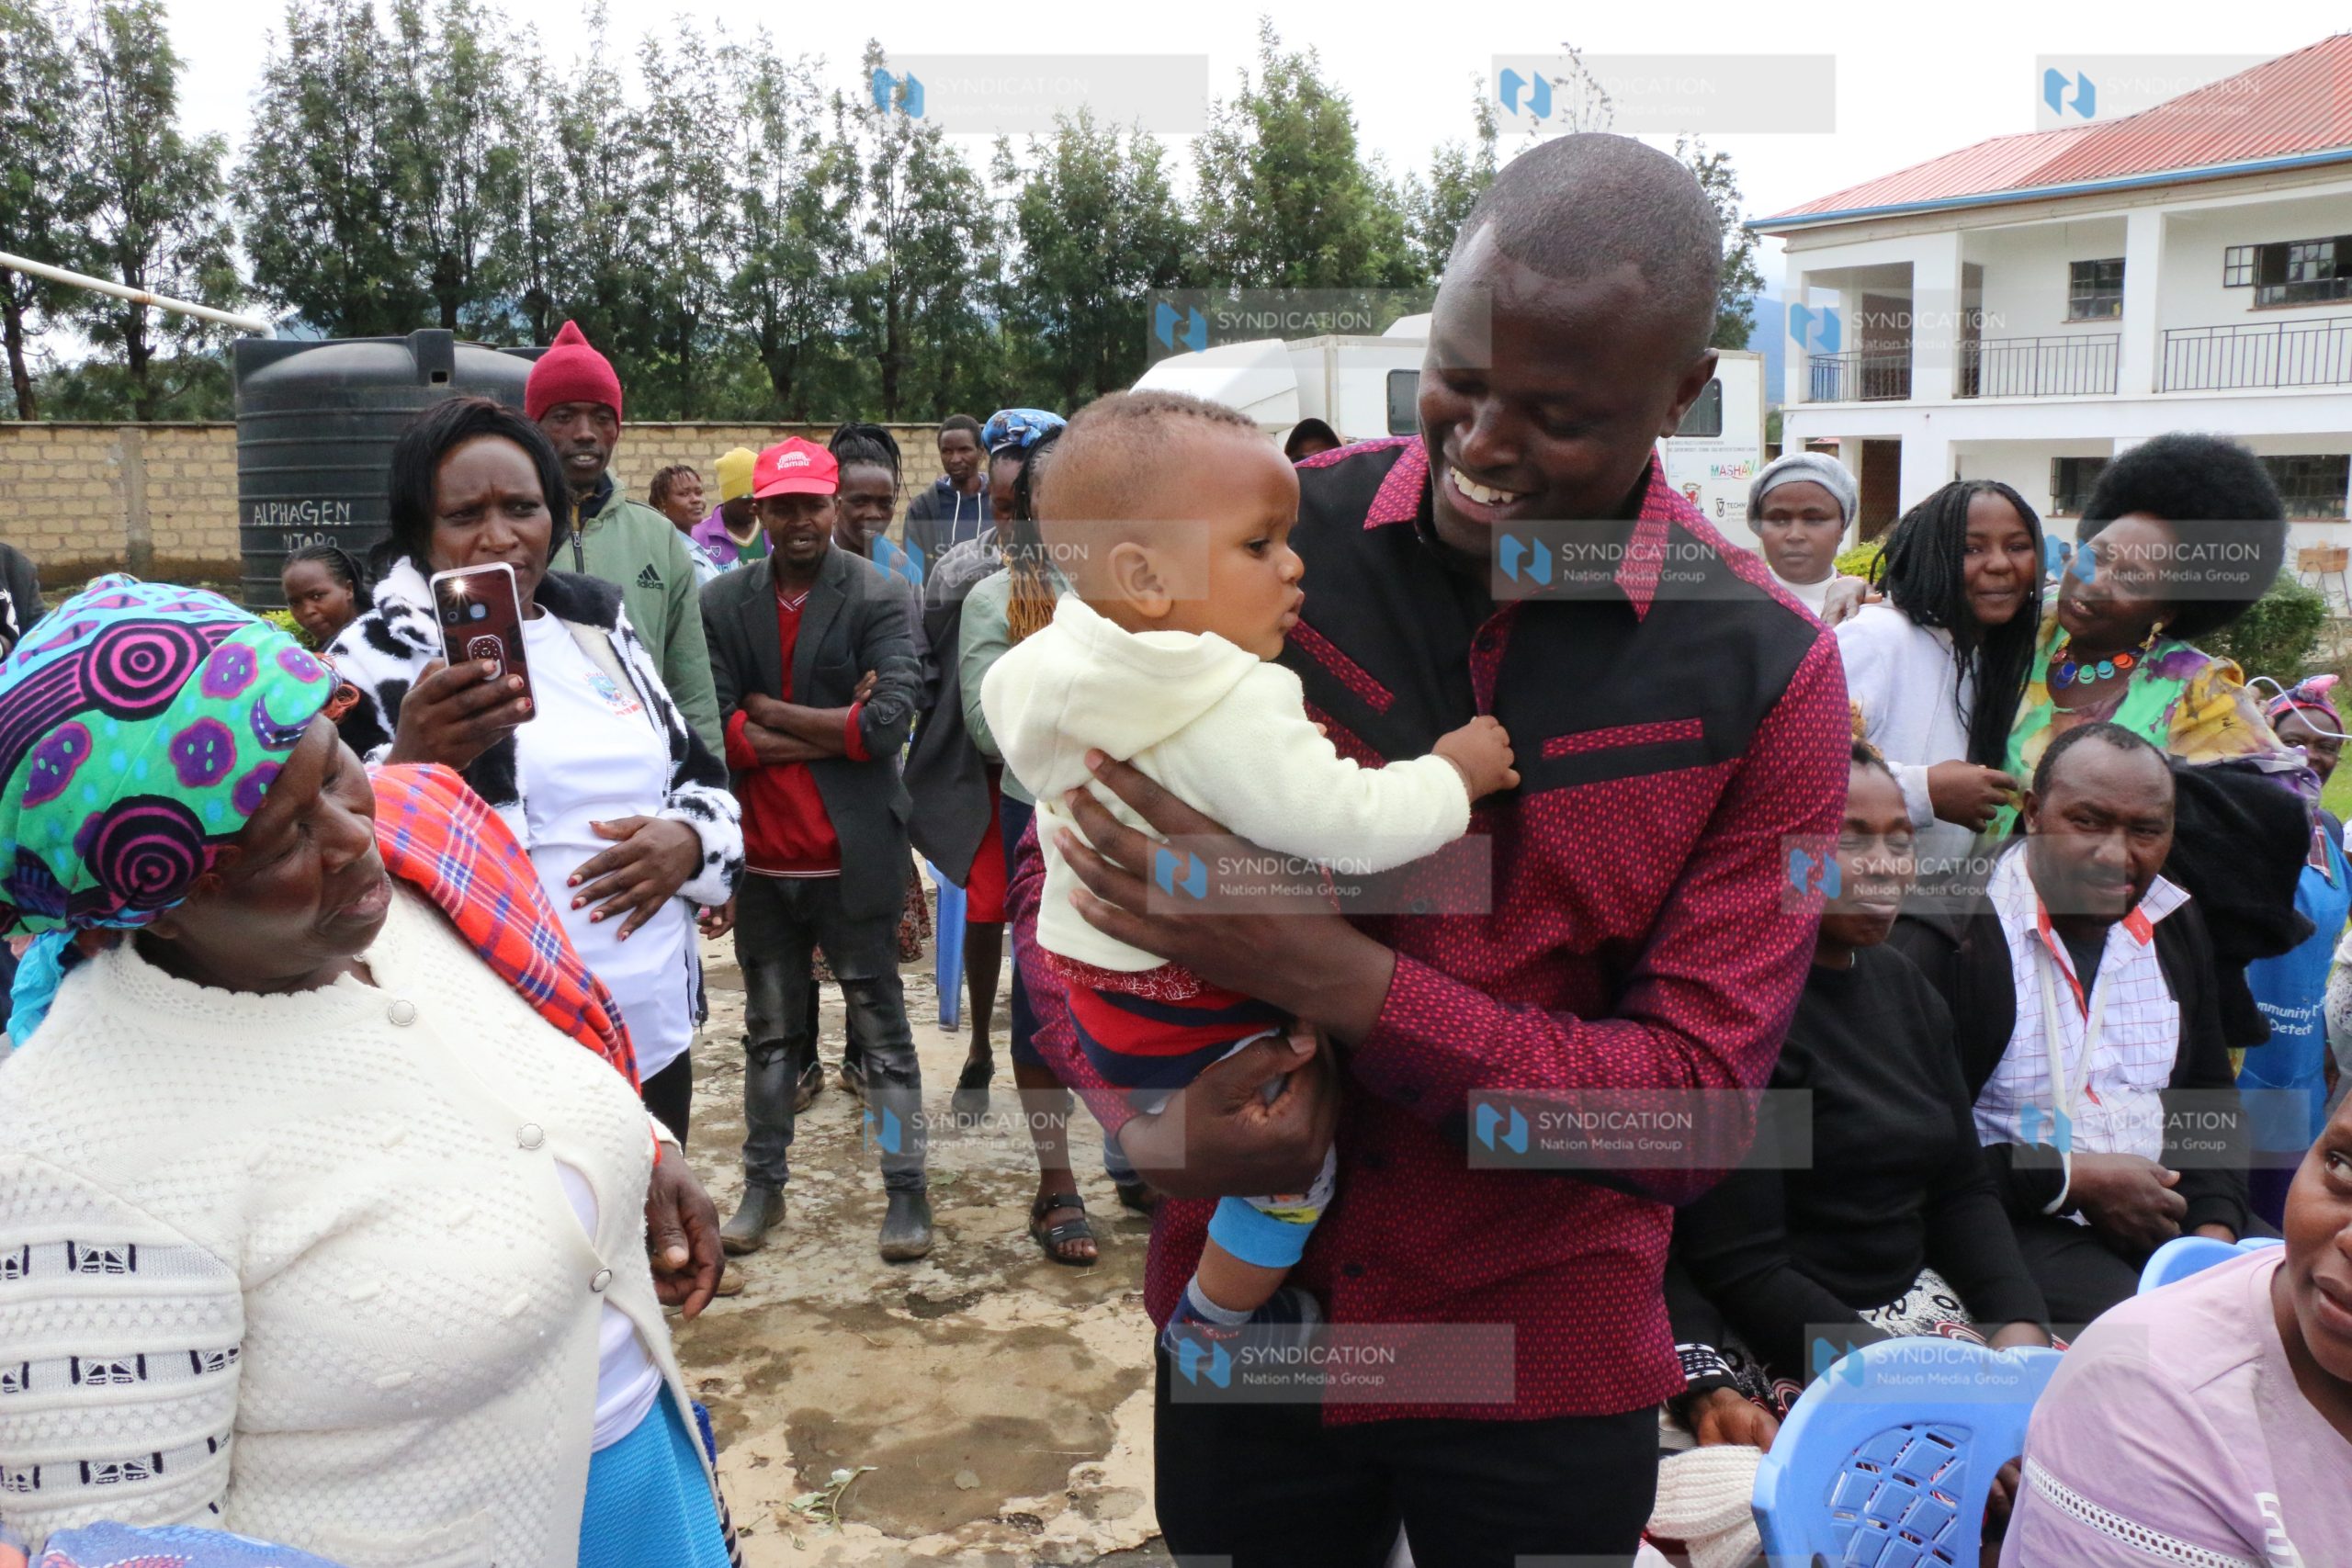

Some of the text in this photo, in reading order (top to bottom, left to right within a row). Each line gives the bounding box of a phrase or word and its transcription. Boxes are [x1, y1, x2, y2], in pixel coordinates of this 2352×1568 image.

[1711, 459, 1757, 477] MASHAV
[253, 500, 350, 525] ALPHAGEN
[2256, 1001, 2311, 1022] mmunity
